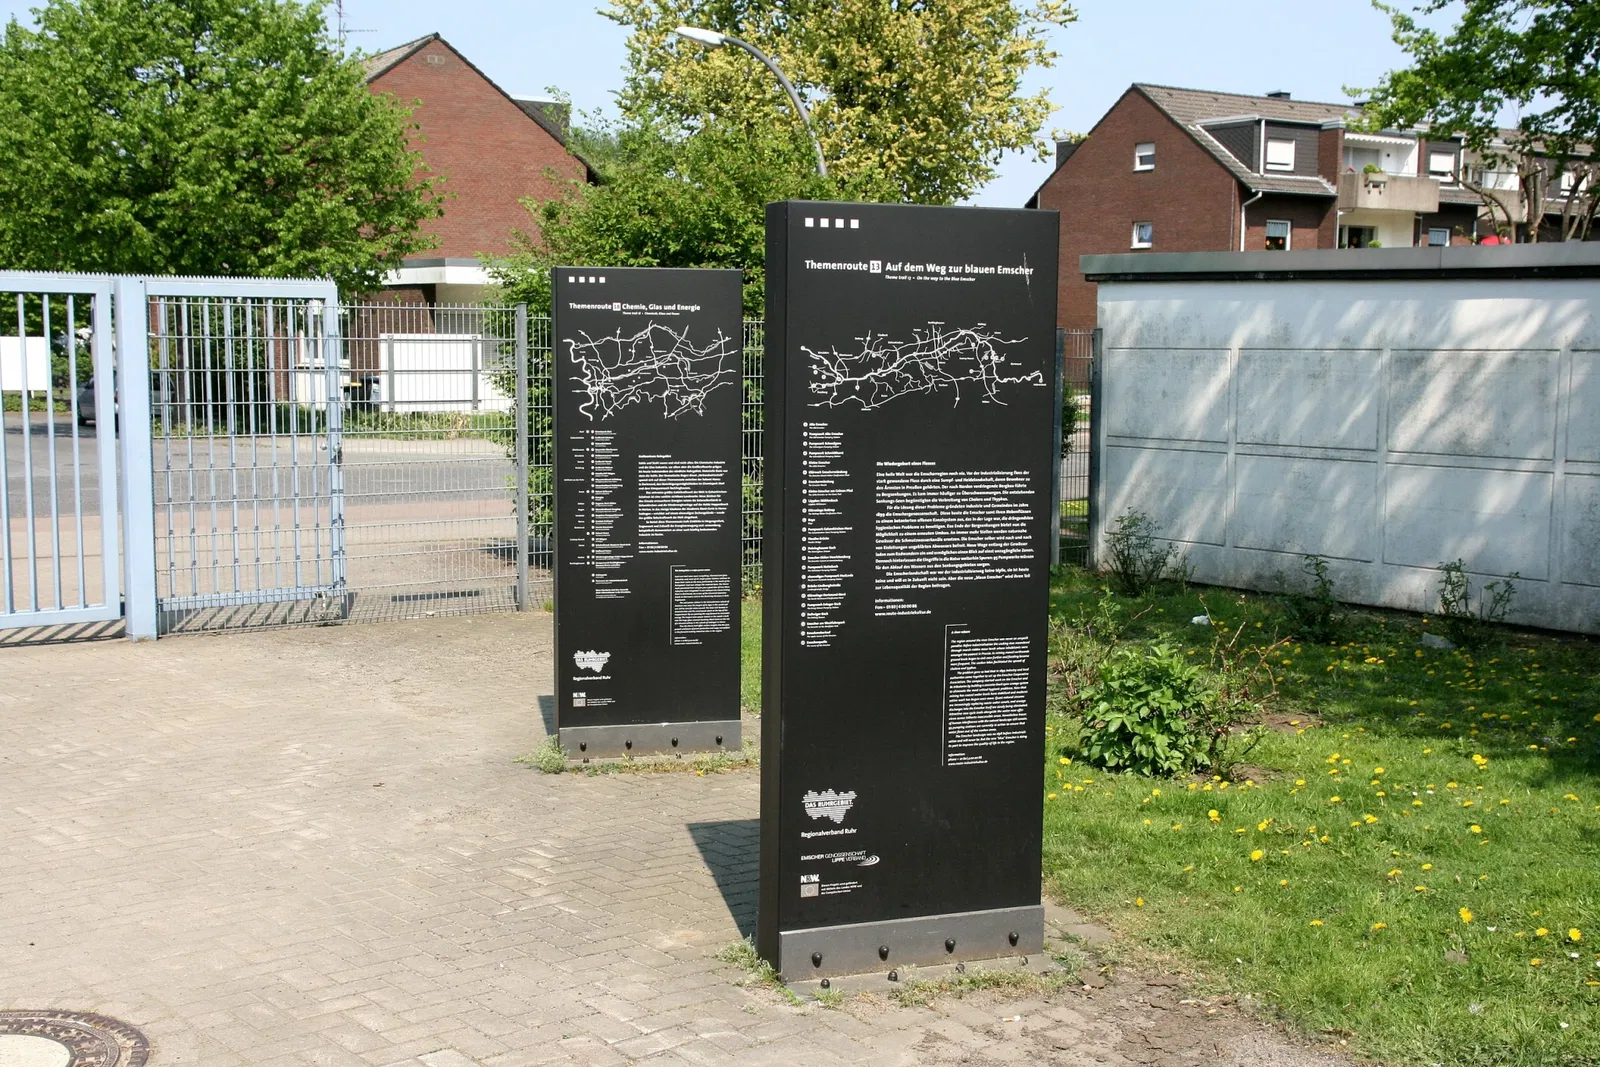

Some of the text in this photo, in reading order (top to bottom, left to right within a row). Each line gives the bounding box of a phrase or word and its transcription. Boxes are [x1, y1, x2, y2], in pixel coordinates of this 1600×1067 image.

[805, 260, 868, 270] Themenroute
[886, 262, 902, 271] Auf
[904, 263, 924, 272] dem
[926, 263, 946, 275] Weg
[948, 265, 962, 273] zur
[965, 264, 995, 274] blauen
[997, 265, 1034, 275] Emscher
[677, 304, 700, 312] Energie
[801, 829, 844, 838] Regionalverband
